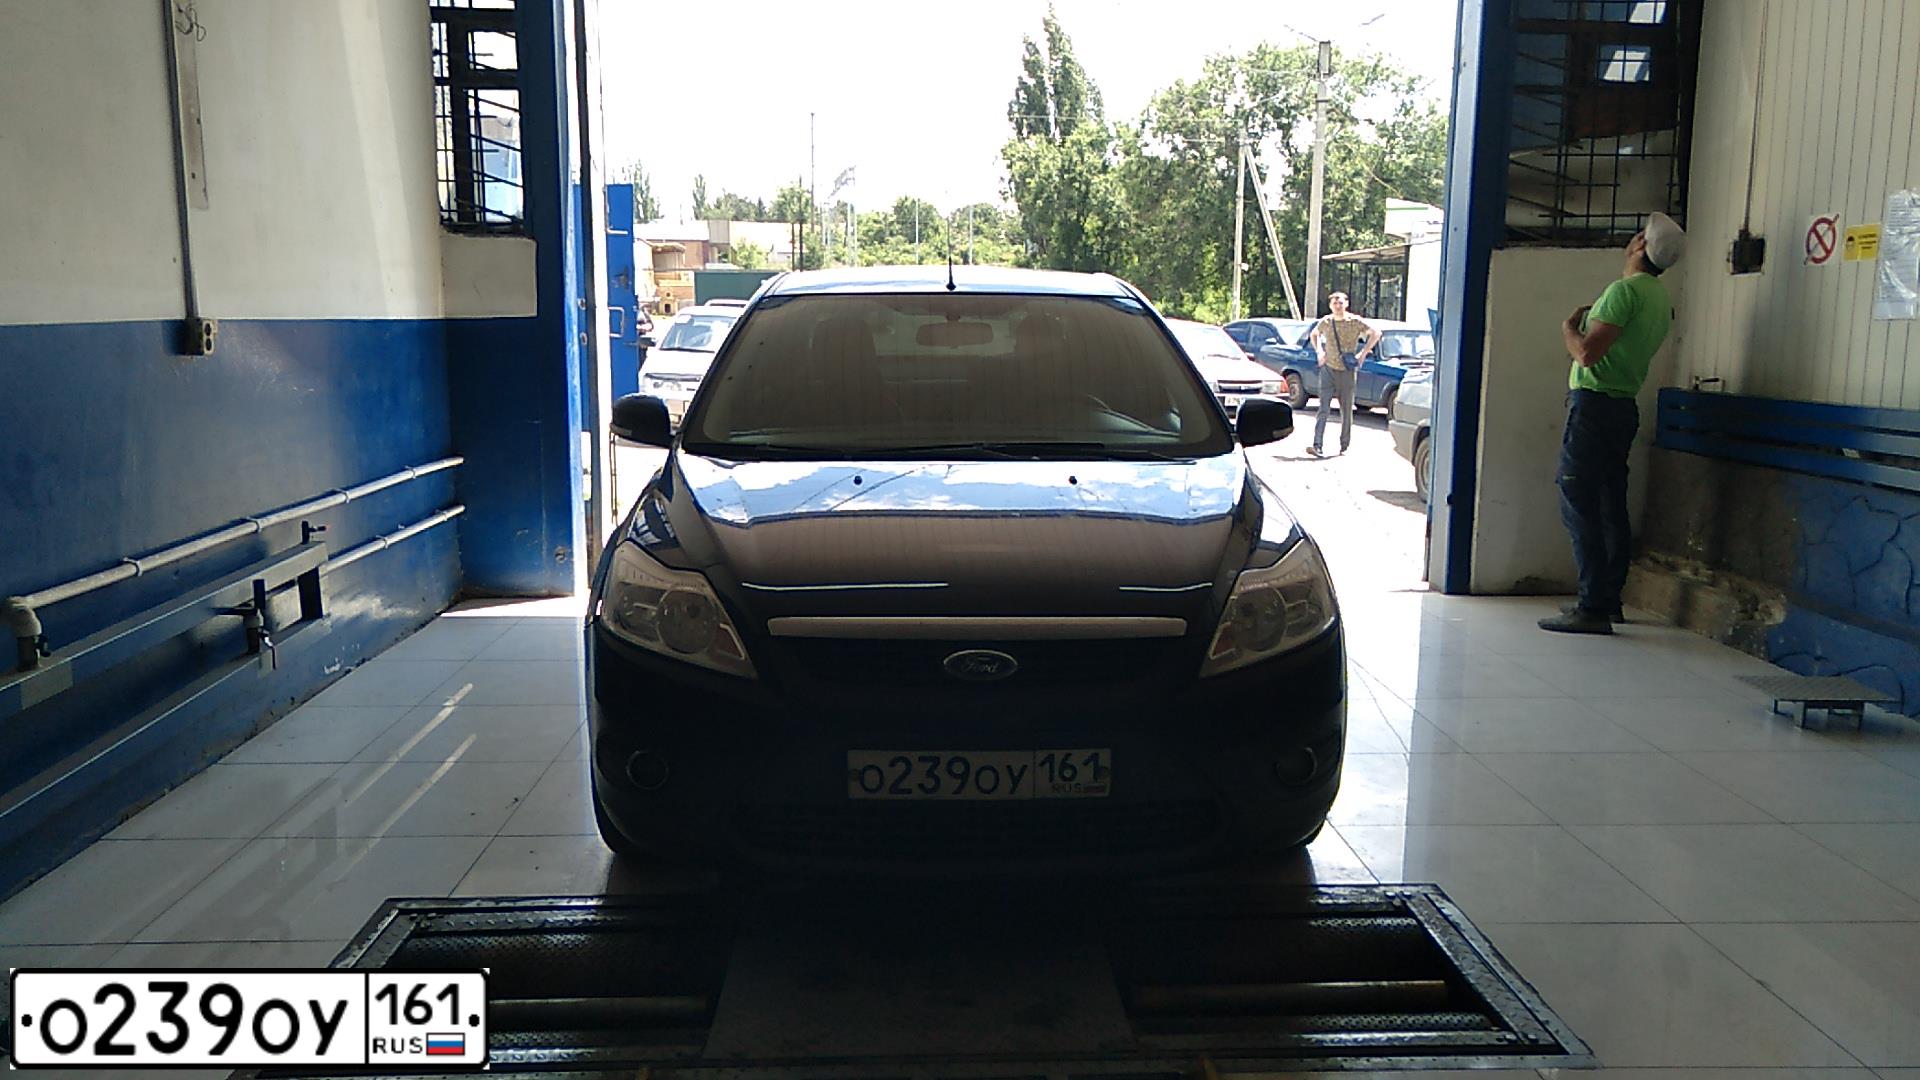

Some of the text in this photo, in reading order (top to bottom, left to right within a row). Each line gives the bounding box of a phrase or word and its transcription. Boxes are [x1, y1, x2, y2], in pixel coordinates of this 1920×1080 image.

[960, 656, 1000, 673] Ford
[1039, 751, 1101, 783] 161
[1051, 783, 1082, 794] RUS
